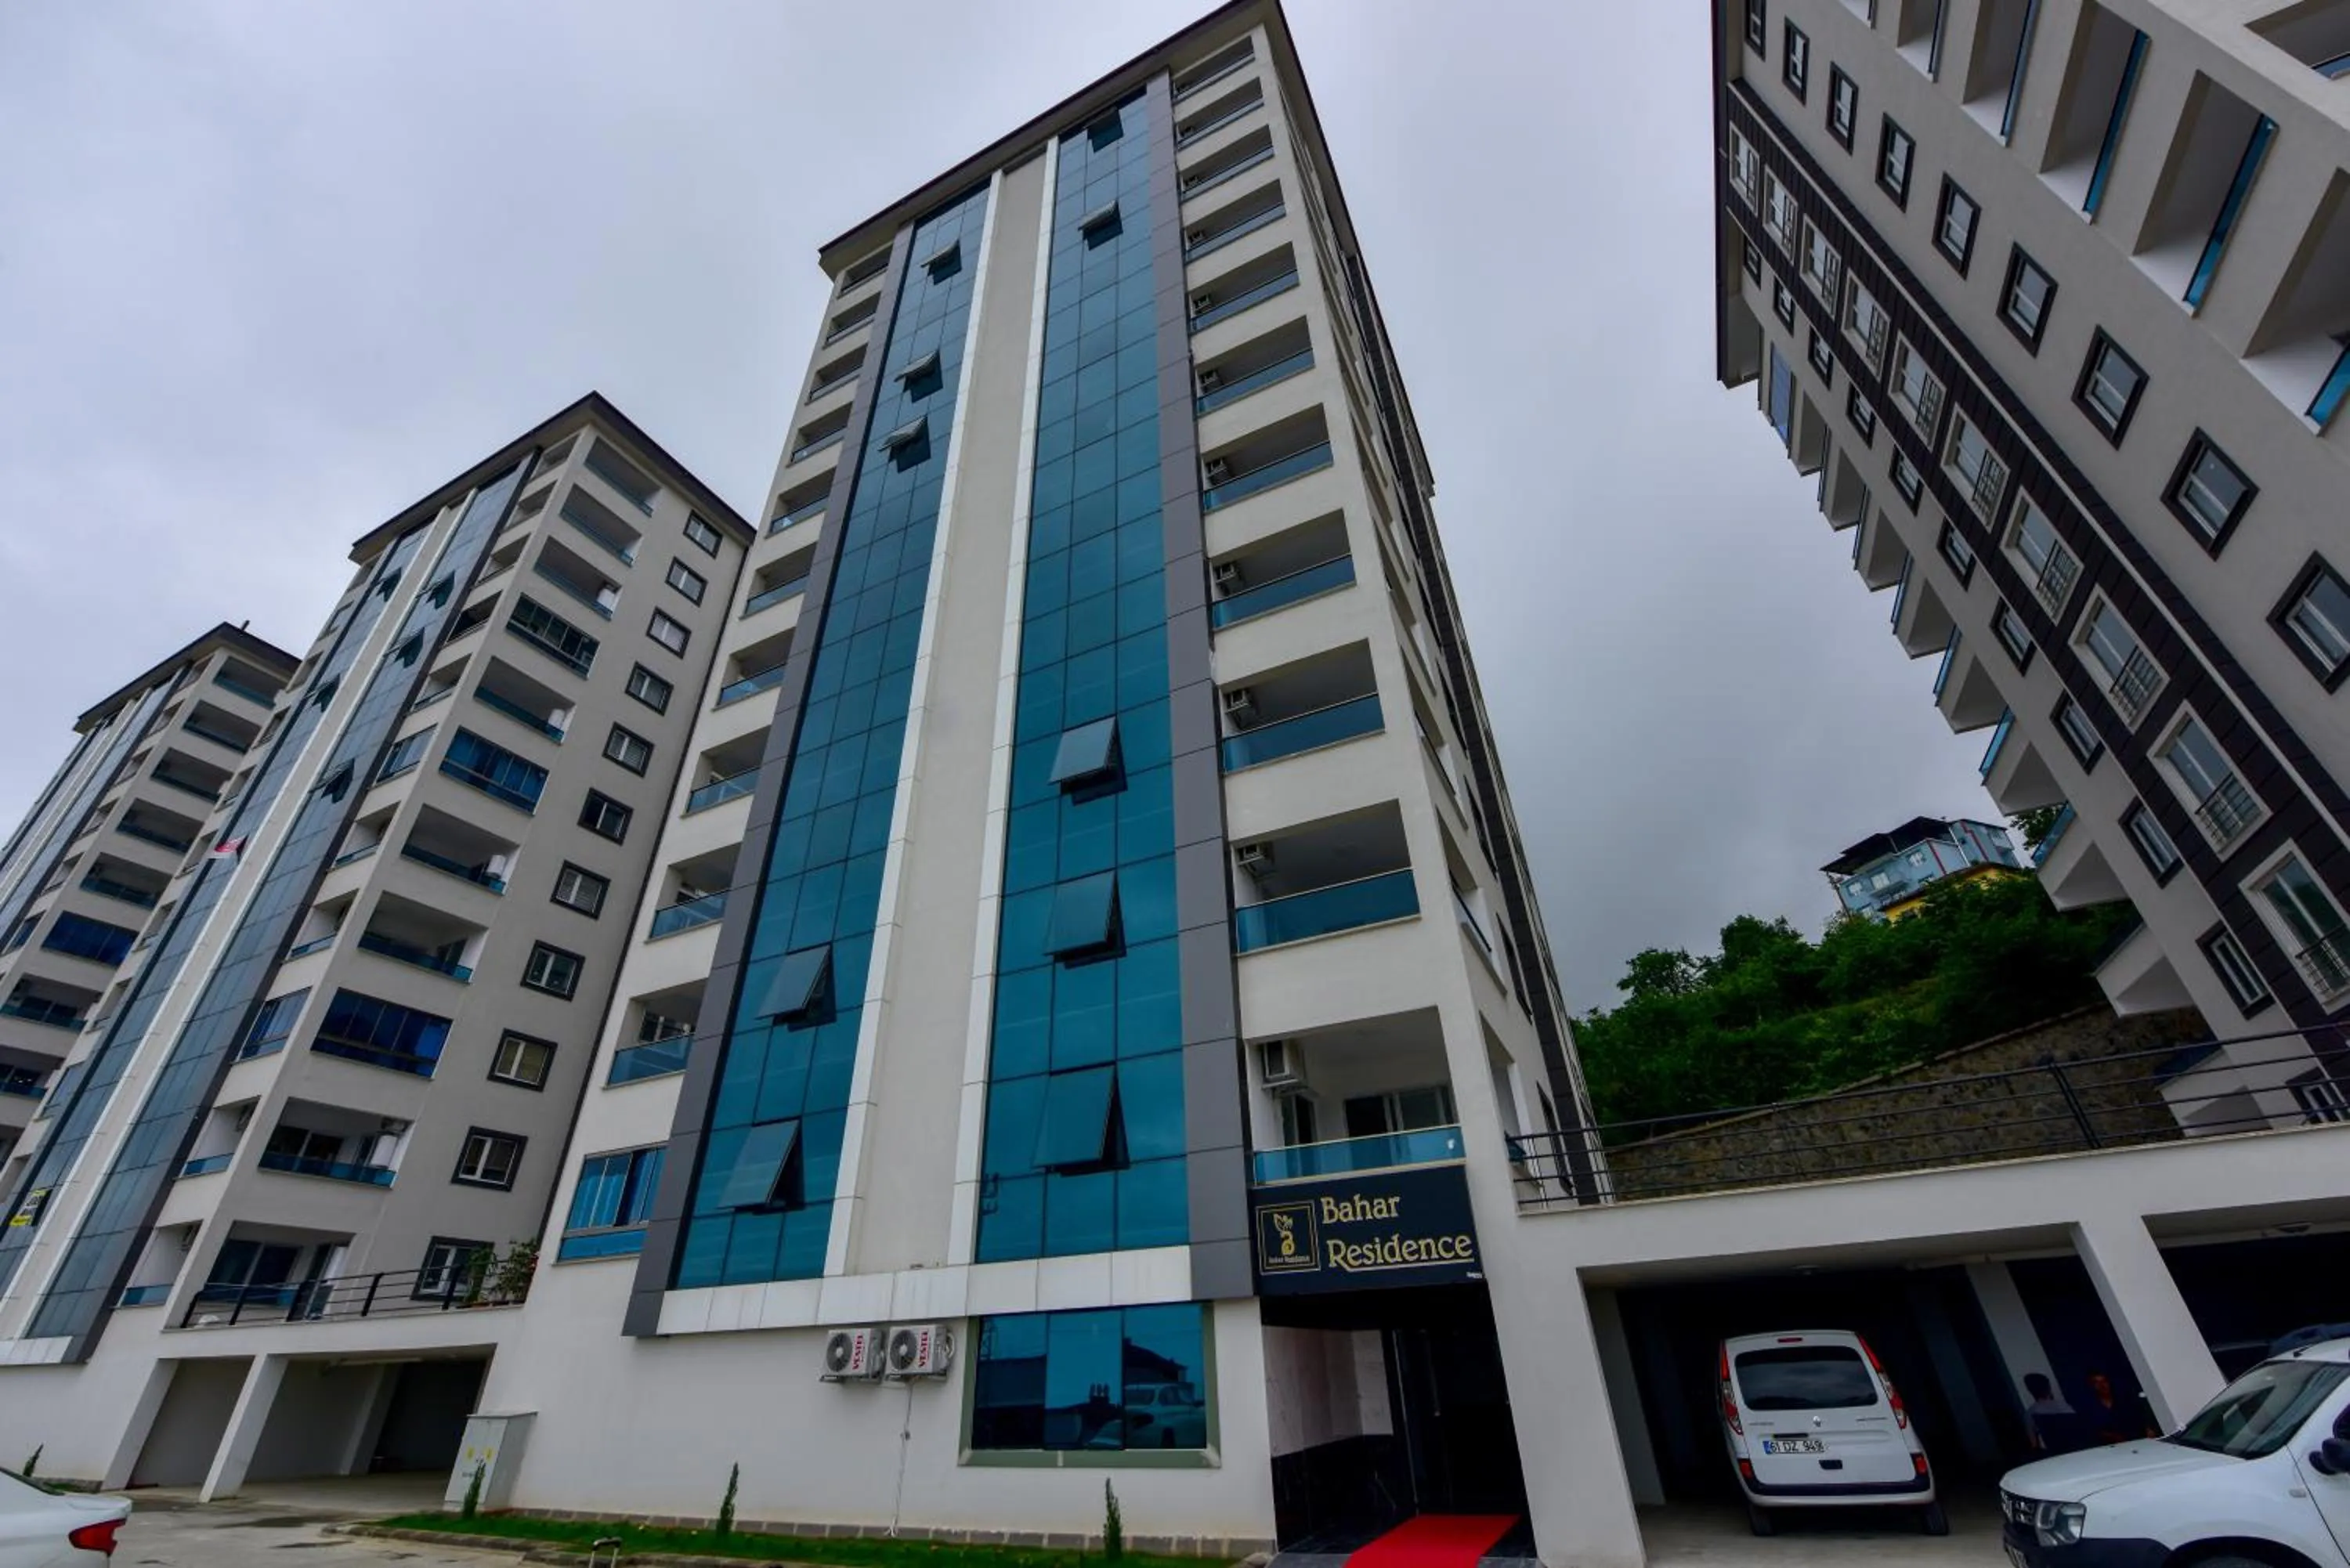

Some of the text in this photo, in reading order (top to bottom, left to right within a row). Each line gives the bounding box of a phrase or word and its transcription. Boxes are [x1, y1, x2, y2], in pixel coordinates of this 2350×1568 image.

[1320, 1193, 1401, 1224] Bahar
[1325, 1233, 1474, 1270] Residence
[918, 1331, 928, 1367] VESTEL
